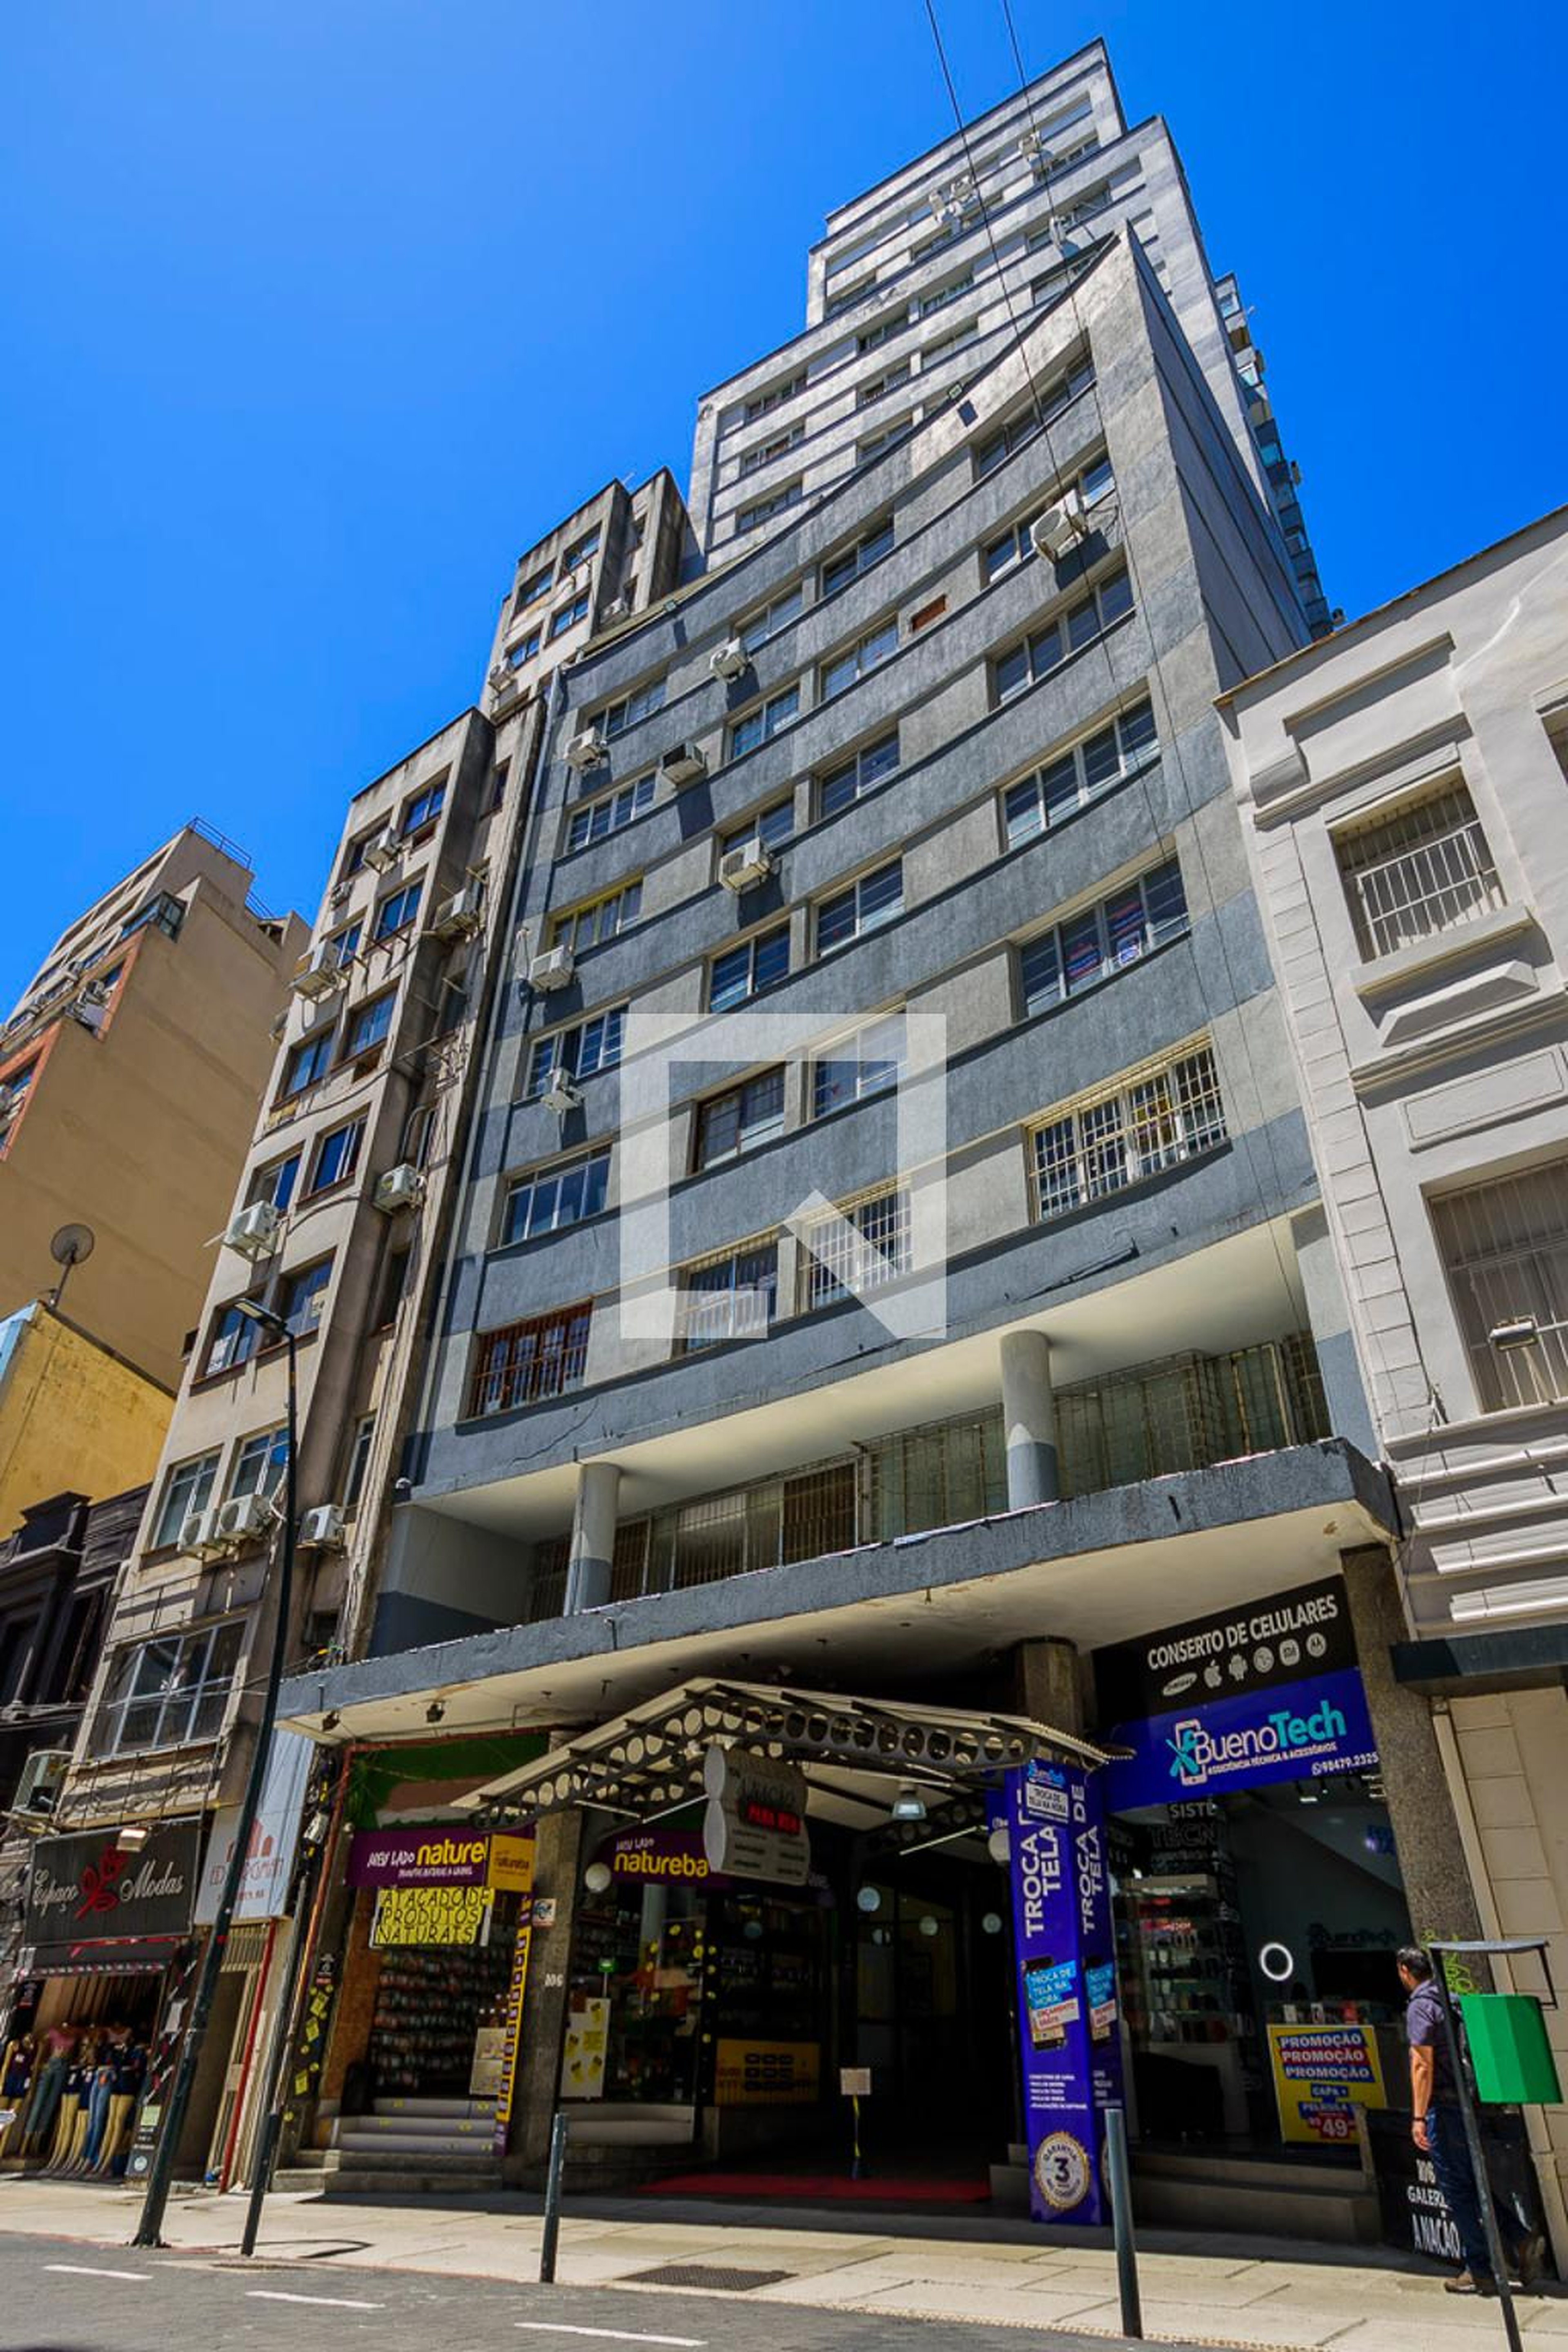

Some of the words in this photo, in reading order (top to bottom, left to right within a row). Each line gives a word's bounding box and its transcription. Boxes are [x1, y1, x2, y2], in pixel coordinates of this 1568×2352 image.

[1148, 1630, 1224, 1670] CONSERTO
[1226, 1623, 1248, 1648] DE
[1250, 1595, 1338, 1640] CELULARES
[1194, 1700, 1346, 1765] BuenoTech
[1071, 1784, 1086, 1823] DE
[417, 1839, 486, 1866] nature
[613, 1850, 708, 1878] natureba
[1039, 1826, 1061, 1896] TELA
[1088, 1825, 1103, 1895] TELA
[120, 1859, 184, 1902] Modas
[1021, 1833, 1044, 1938] TROCA
[1076, 1833, 1095, 1935] TROCA
[384, 1905, 479, 1925] PRODUTOS
[378, 1925, 473, 1944] NATURAIS
[1280, 2032, 1361, 2048] PROMOÇÃO
[1281, 2049, 1365, 2064] PROMOÇÃO
[1285, 2065, 1370, 2079] PROMOÇÃO
[1322, 2118, 1348, 2138] 49
[1055, 2157, 1070, 2183] 3
[1407, 2185, 1450, 2210] GALERI
